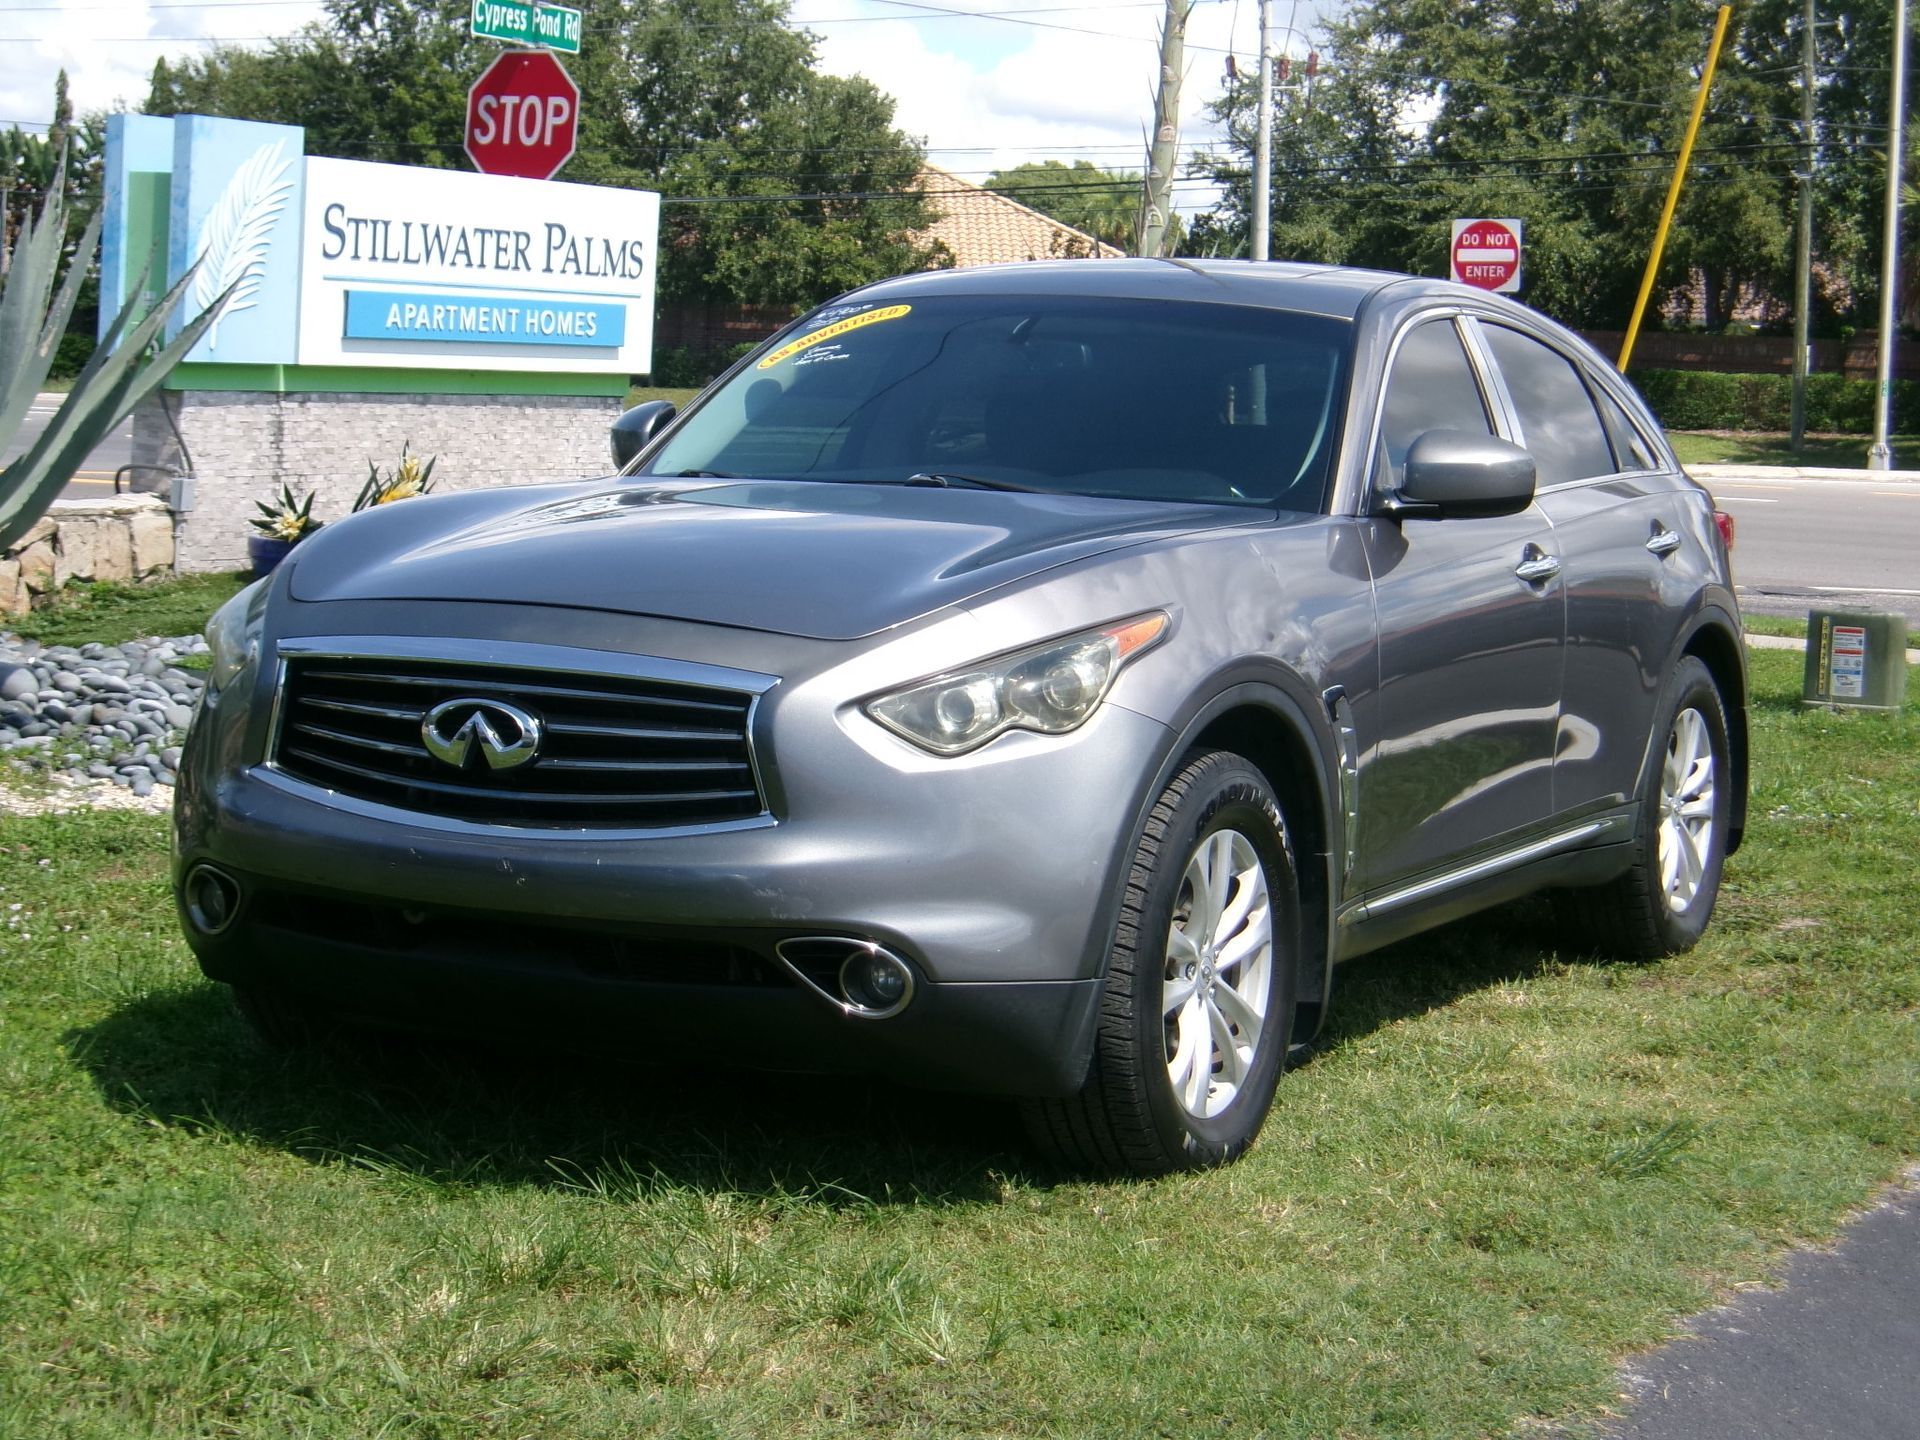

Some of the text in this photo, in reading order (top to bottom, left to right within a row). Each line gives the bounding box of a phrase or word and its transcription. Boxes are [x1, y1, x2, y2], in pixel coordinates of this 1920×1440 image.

[475, 0, 578, 41] Cypress Pond Rd
[474, 94, 570, 146] STOP
[322, 203, 643, 280] STILLWATER PALMS
[1462, 233, 1511, 245] DO NOT
[1465, 265, 1505, 277] ENTER
[385, 303, 598, 337] APARTMENT HOMES
[796, 307, 900, 349] ADVERTISED
